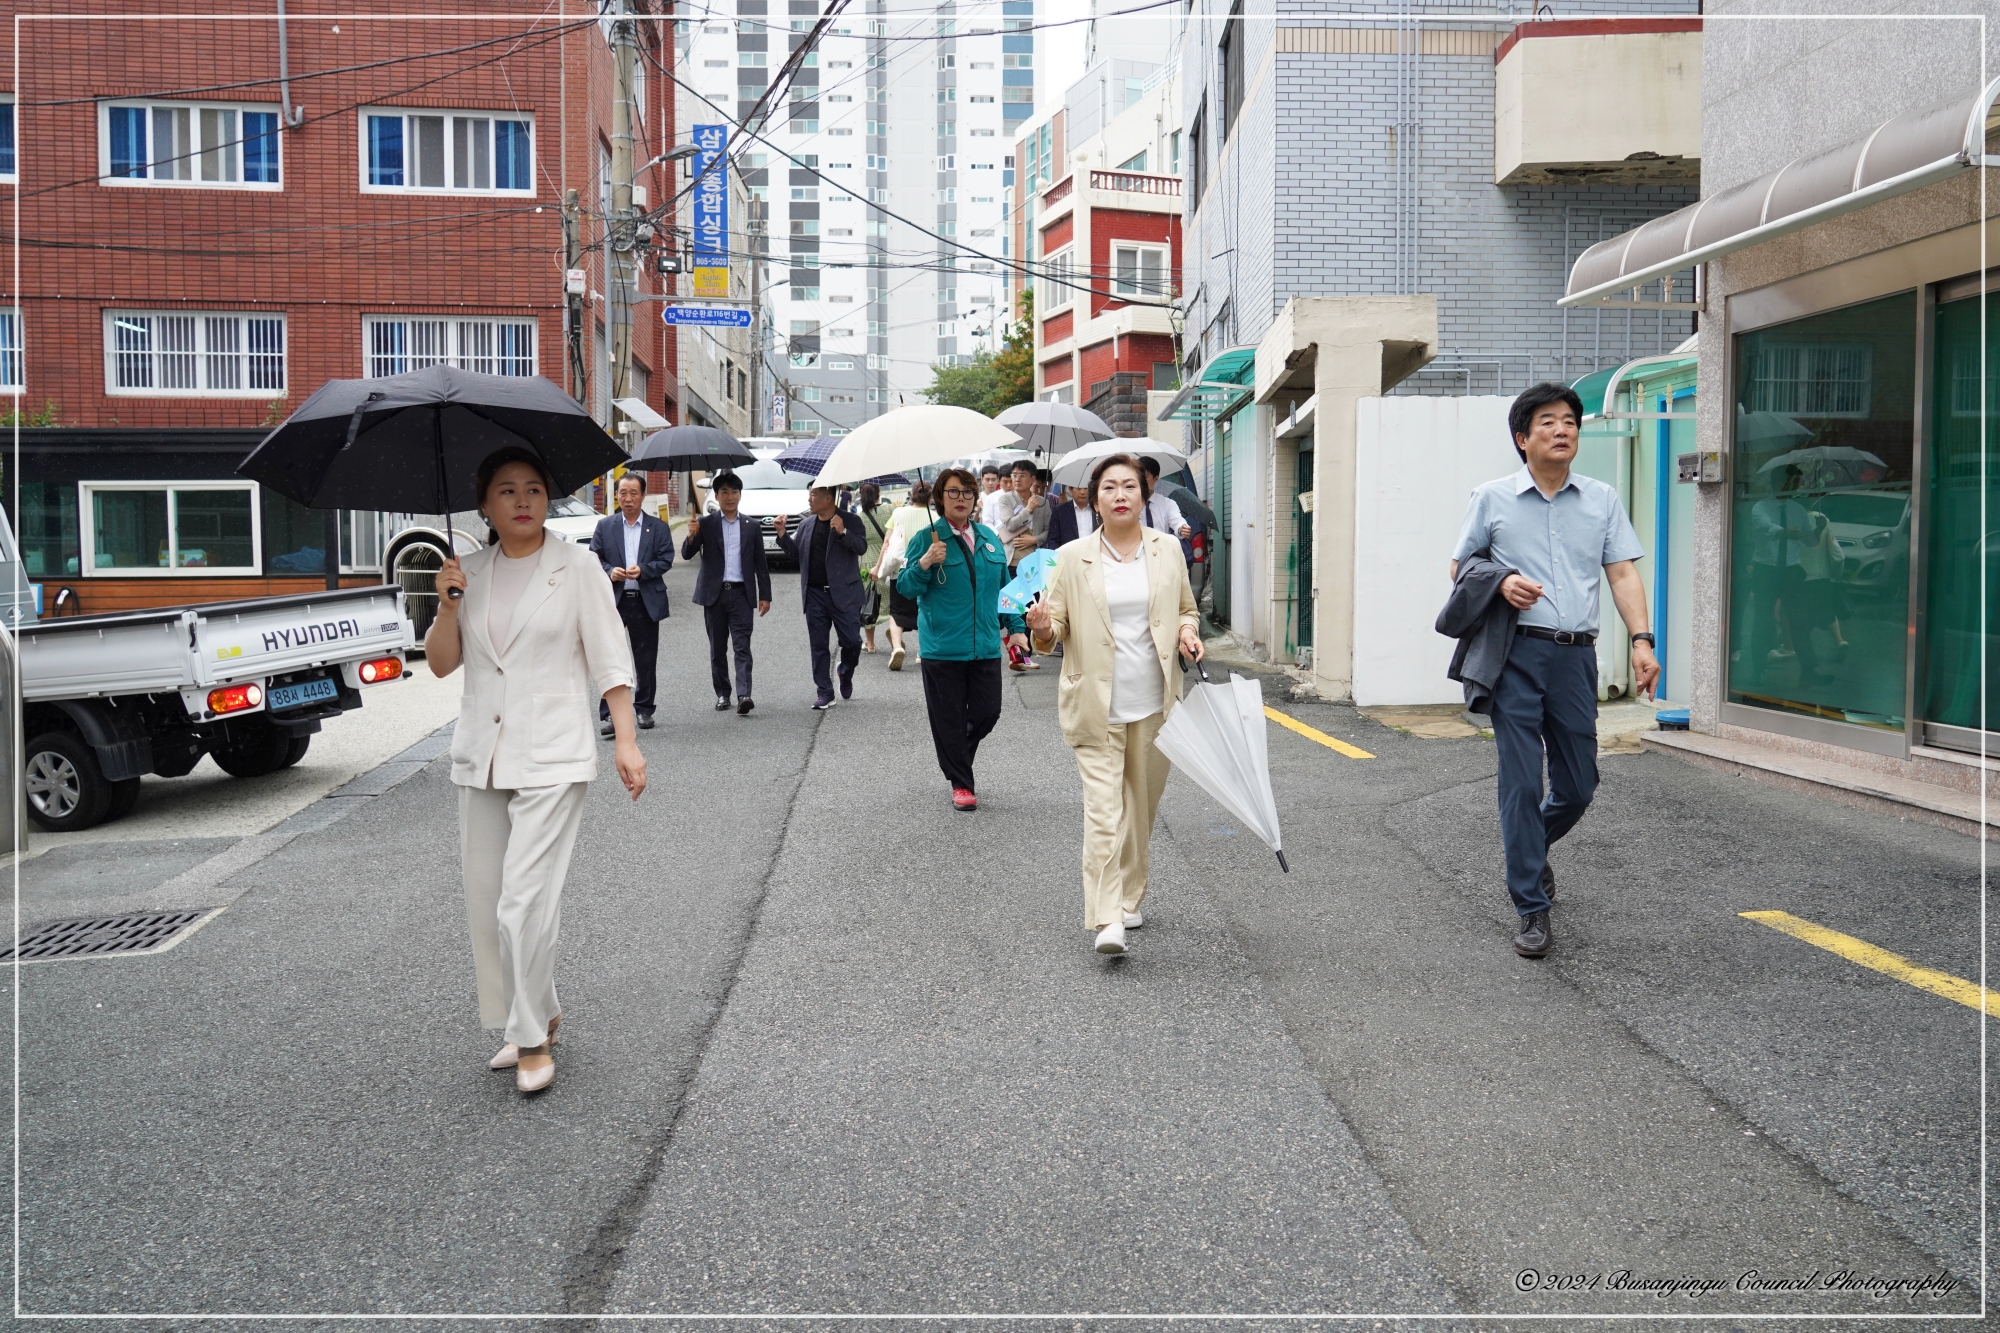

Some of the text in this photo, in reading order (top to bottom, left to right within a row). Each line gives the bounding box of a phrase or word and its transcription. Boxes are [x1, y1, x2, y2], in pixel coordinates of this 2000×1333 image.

[699, 129, 723, 254] 삼호종합싱크
[677, 308, 738, 320] 백양순환로116번길
[261, 618, 359, 652] HYUNDAI
[274, 681, 331, 705] 88서 4448
